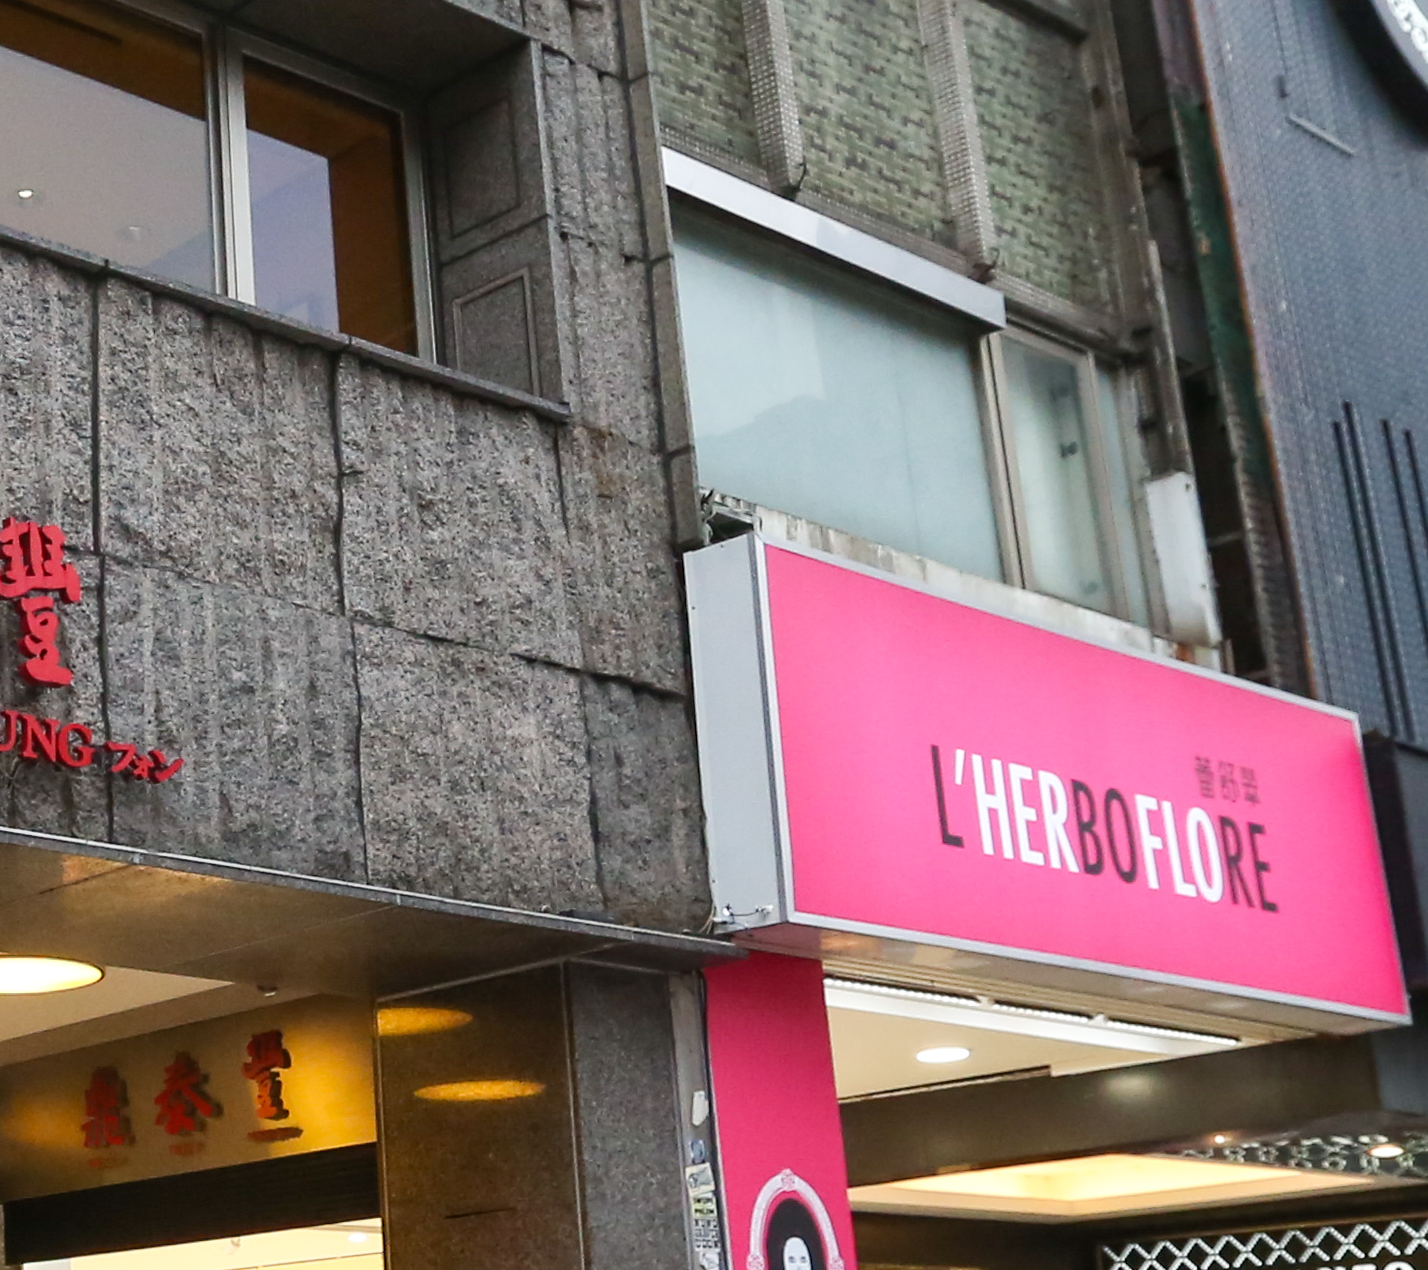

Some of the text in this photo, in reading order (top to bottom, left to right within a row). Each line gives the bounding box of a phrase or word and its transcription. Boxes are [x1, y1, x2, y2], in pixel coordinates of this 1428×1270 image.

[104, 740, 184, 785] フォン
[930, 744, 1279, 913] L'HERBOFLORE
